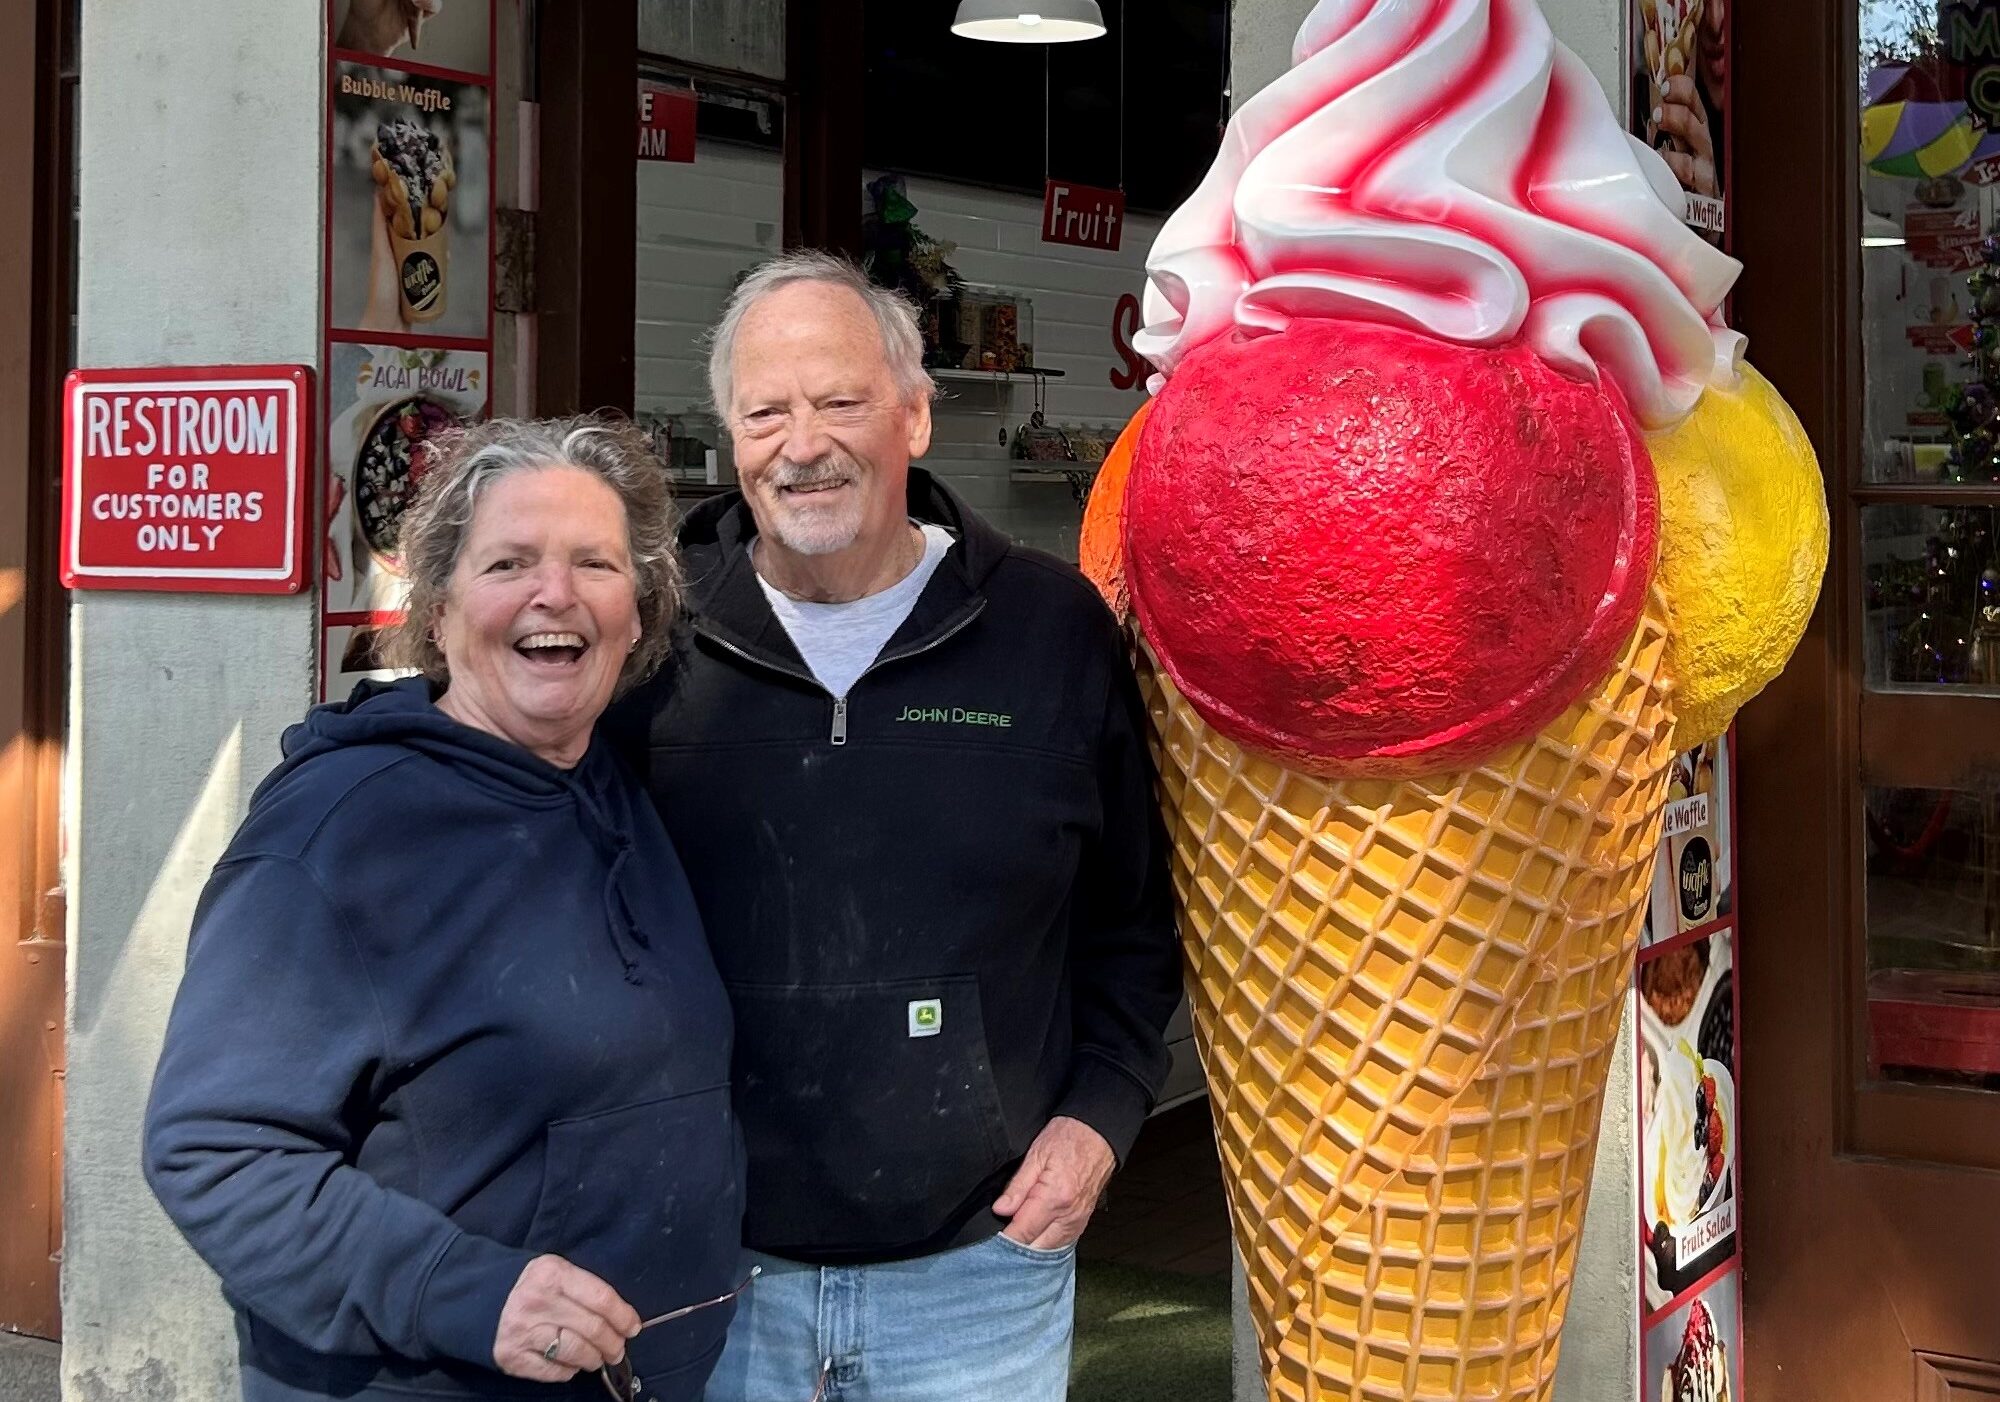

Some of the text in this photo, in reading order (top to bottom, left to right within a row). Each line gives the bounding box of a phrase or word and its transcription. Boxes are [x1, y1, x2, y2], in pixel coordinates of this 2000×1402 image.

[341, 75, 451, 112] Bubble Waffle
[1050, 186, 1116, 244] Fruit
[1692, 200, 1723, 230] Waffle
[373, 364, 468, 392] ACAI BOWL
[88, 395, 278, 457] RESTROOM
[147, 463, 209, 490] FOR
[92, 492, 263, 521] CUSTOMERS
[137, 524, 224, 551] ONLY
[896, 705, 1012, 727] JOHN DEERE
[1674, 800, 1706, 830] Waffle
[1682, 1206, 1731, 1260] Fruit Salad
